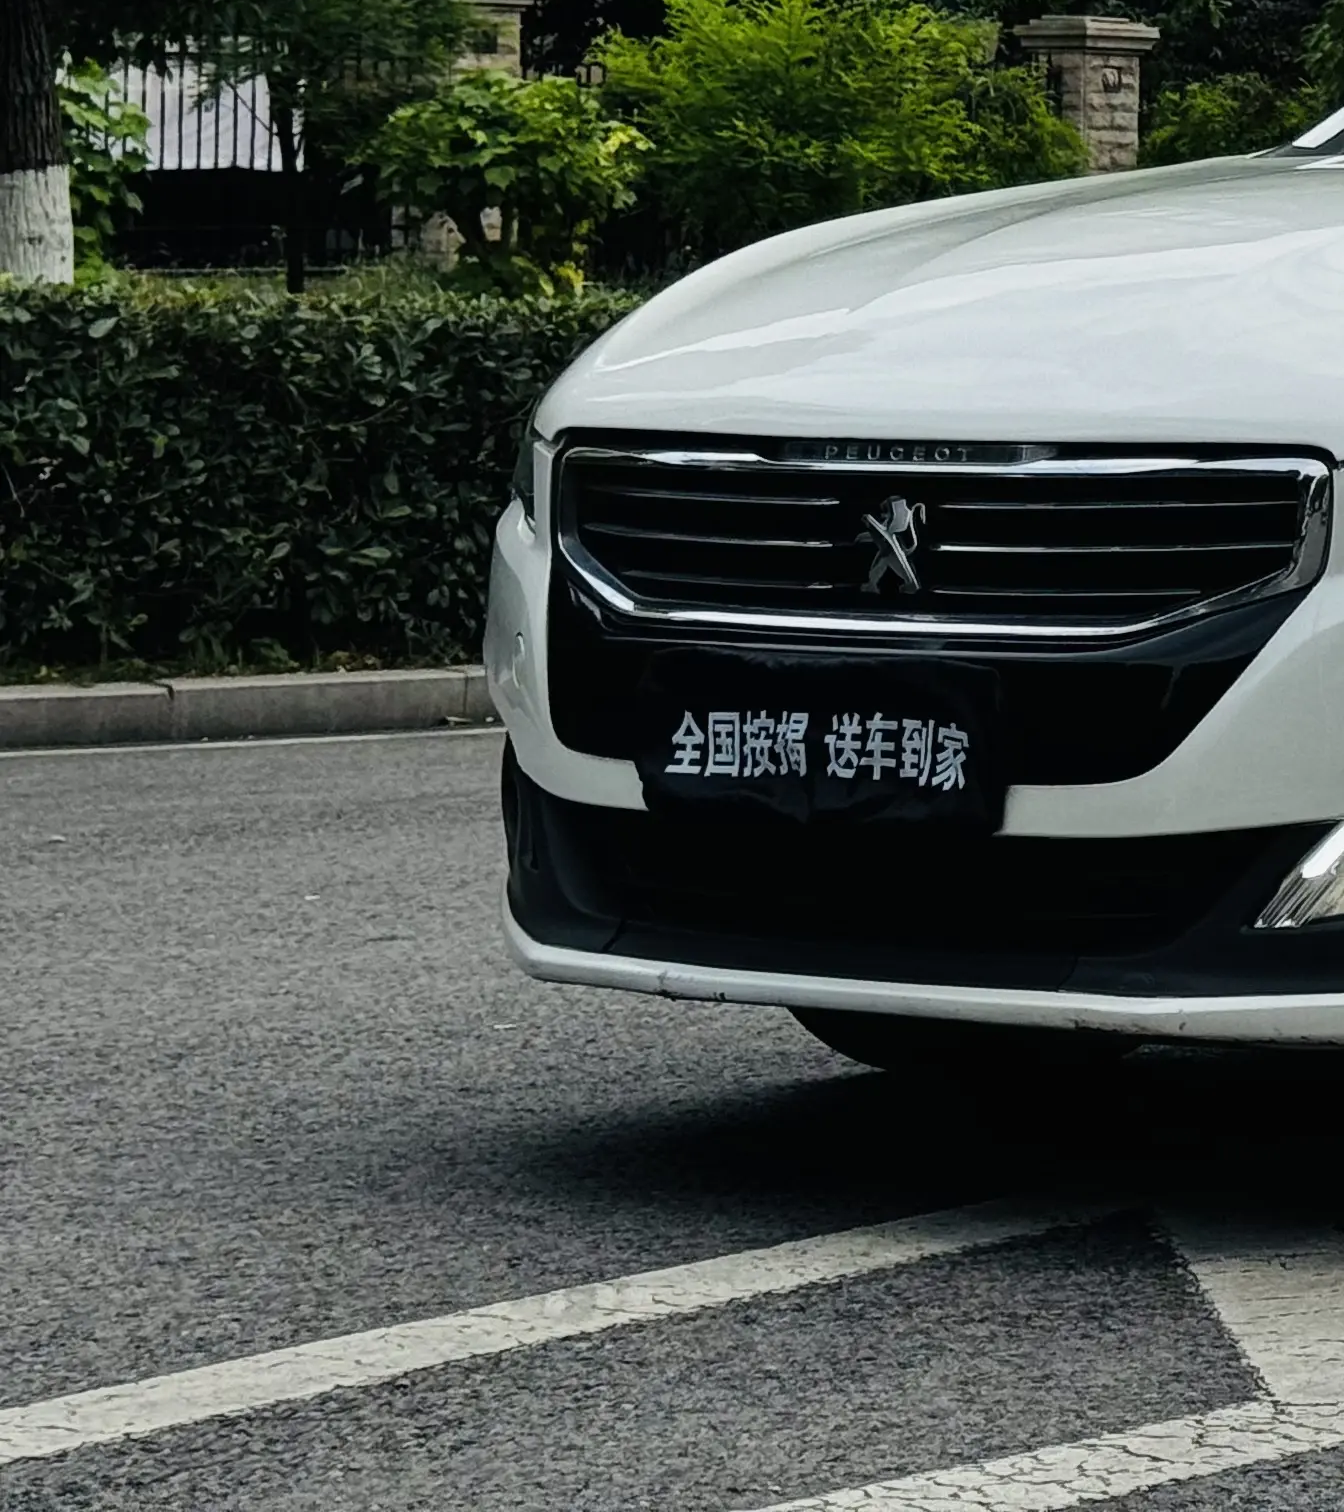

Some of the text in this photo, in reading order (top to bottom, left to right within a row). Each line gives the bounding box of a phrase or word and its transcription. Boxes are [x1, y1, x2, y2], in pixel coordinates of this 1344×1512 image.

[825, 444, 971, 462] PEUGEOT
[664, 709, 970, 791] 全国按揭 送车到家
